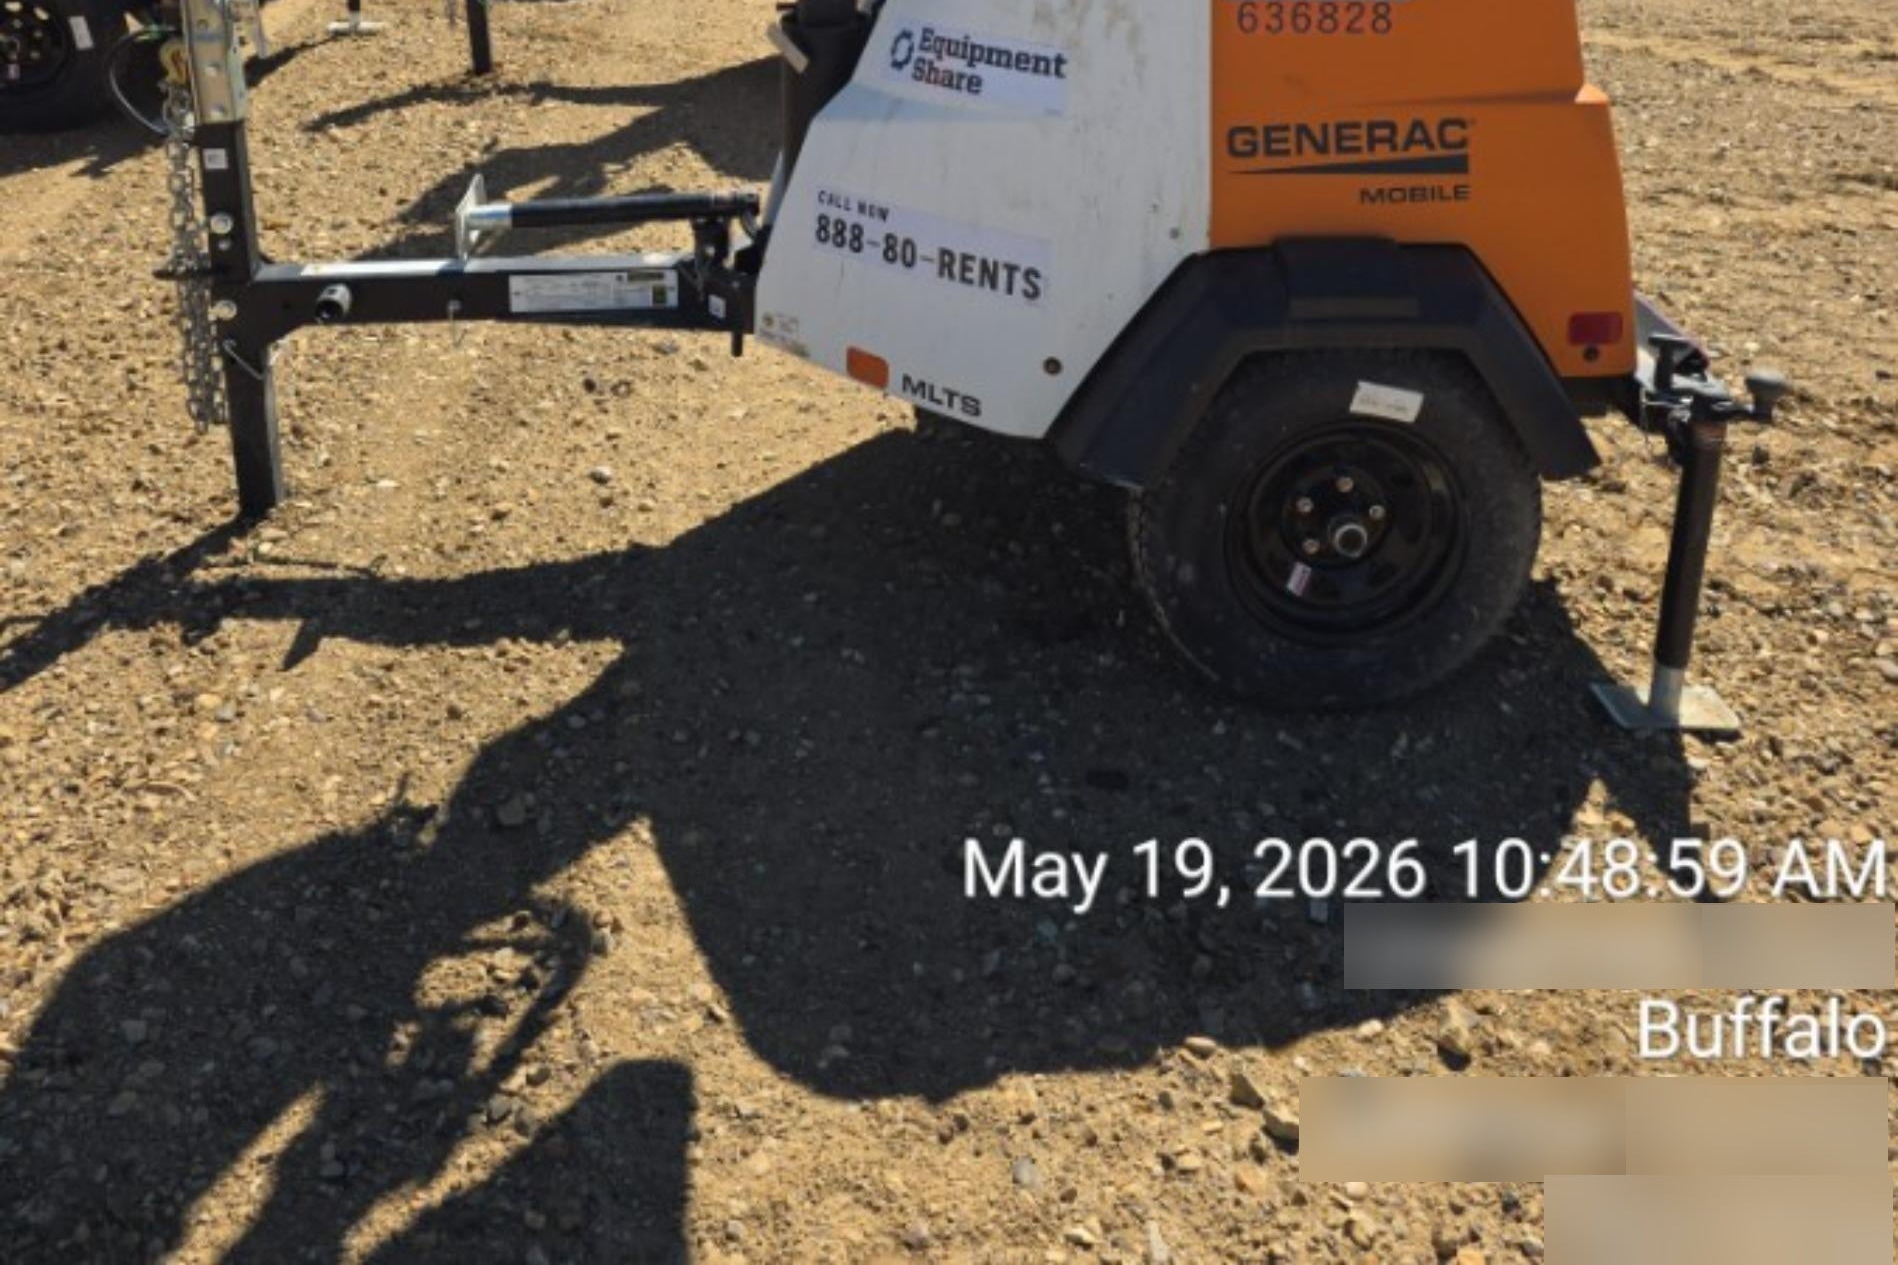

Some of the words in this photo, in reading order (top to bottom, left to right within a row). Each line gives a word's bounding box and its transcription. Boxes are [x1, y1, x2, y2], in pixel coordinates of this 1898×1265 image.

[1236, 0, 1394, 35] 636828
[918, 26, 1069, 79] Equipment
[910, 56, 984, 96] Share
[1226, 117, 1469, 159] GENERAC
[817, 189, 852, 212] CALL
[857, 201, 890, 223] NOW
[1359, 184, 1470, 205] MOBILE
[814, 212, 1043, 301] 888-80-RENTS
[901, 373, 983, 418] MLTS
